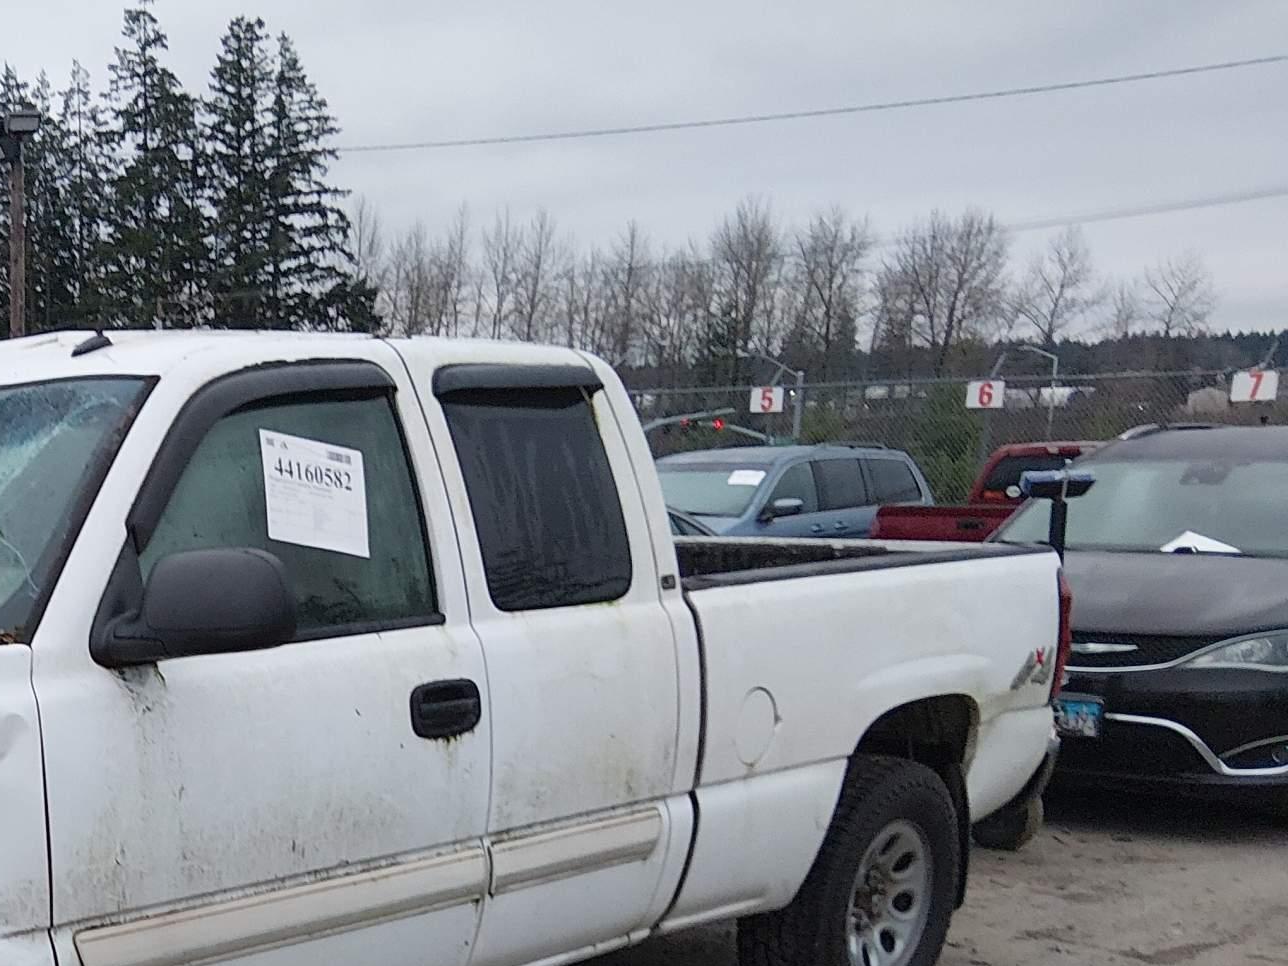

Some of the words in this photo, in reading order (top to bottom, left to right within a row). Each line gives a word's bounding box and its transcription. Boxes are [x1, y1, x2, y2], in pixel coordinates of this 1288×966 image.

[760, 387, 774, 412] 5
[978, 382, 994, 408] 6
[1249, 369, 1264, 401] 7
[274, 456, 352, 492] 44160582
